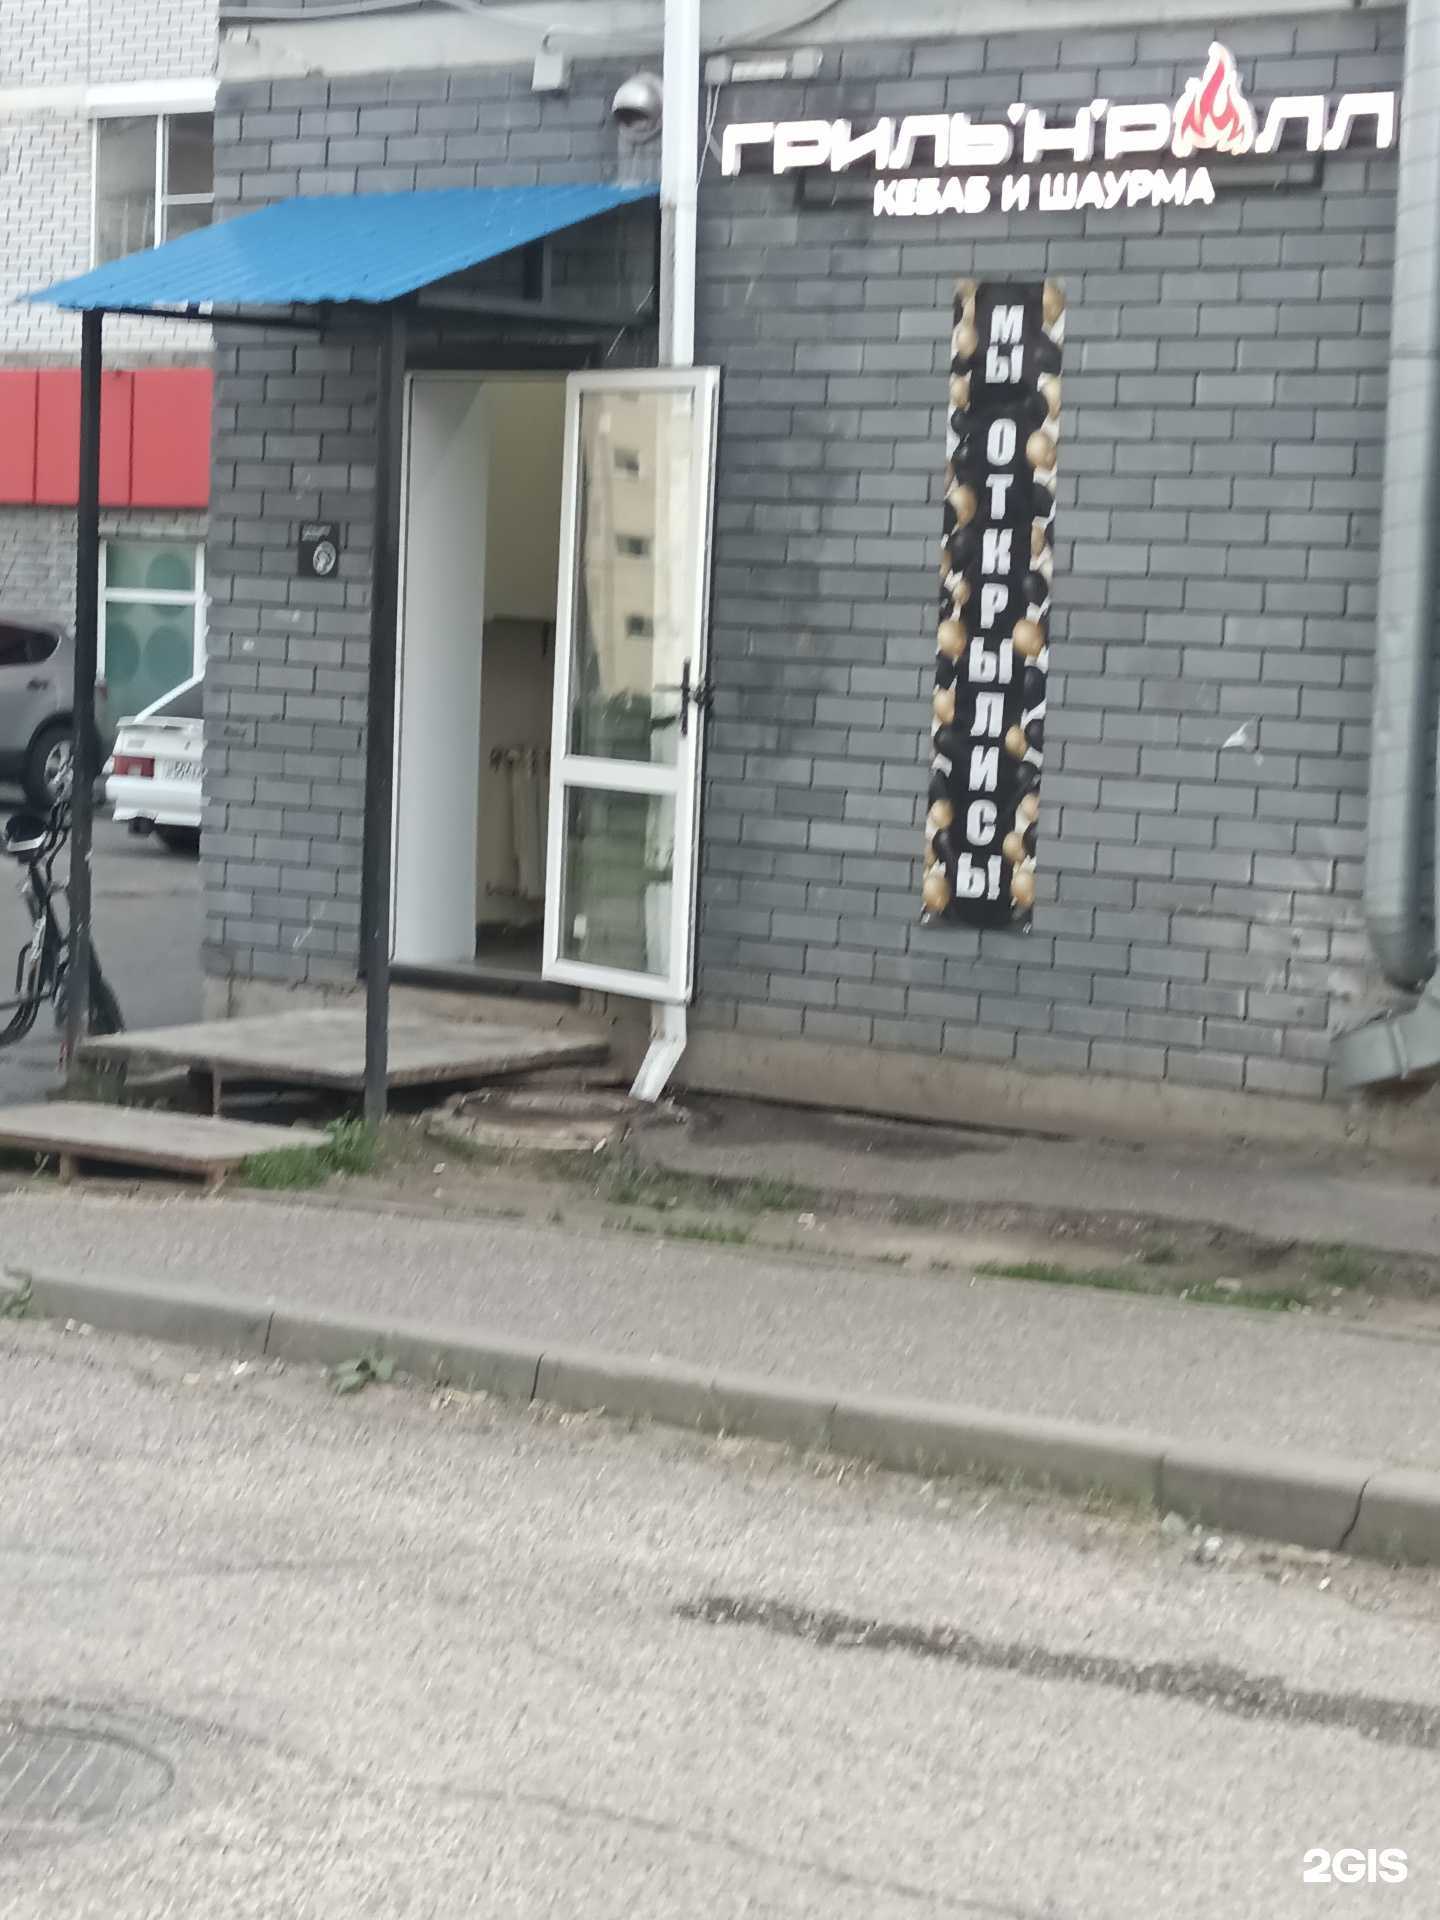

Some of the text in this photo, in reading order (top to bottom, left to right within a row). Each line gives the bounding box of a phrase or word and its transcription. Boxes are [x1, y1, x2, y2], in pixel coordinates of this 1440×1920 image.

[873, 167, 1215, 216] КЕБАБ И ШАУРМА
[985, 304, 1025, 384] МЫ
